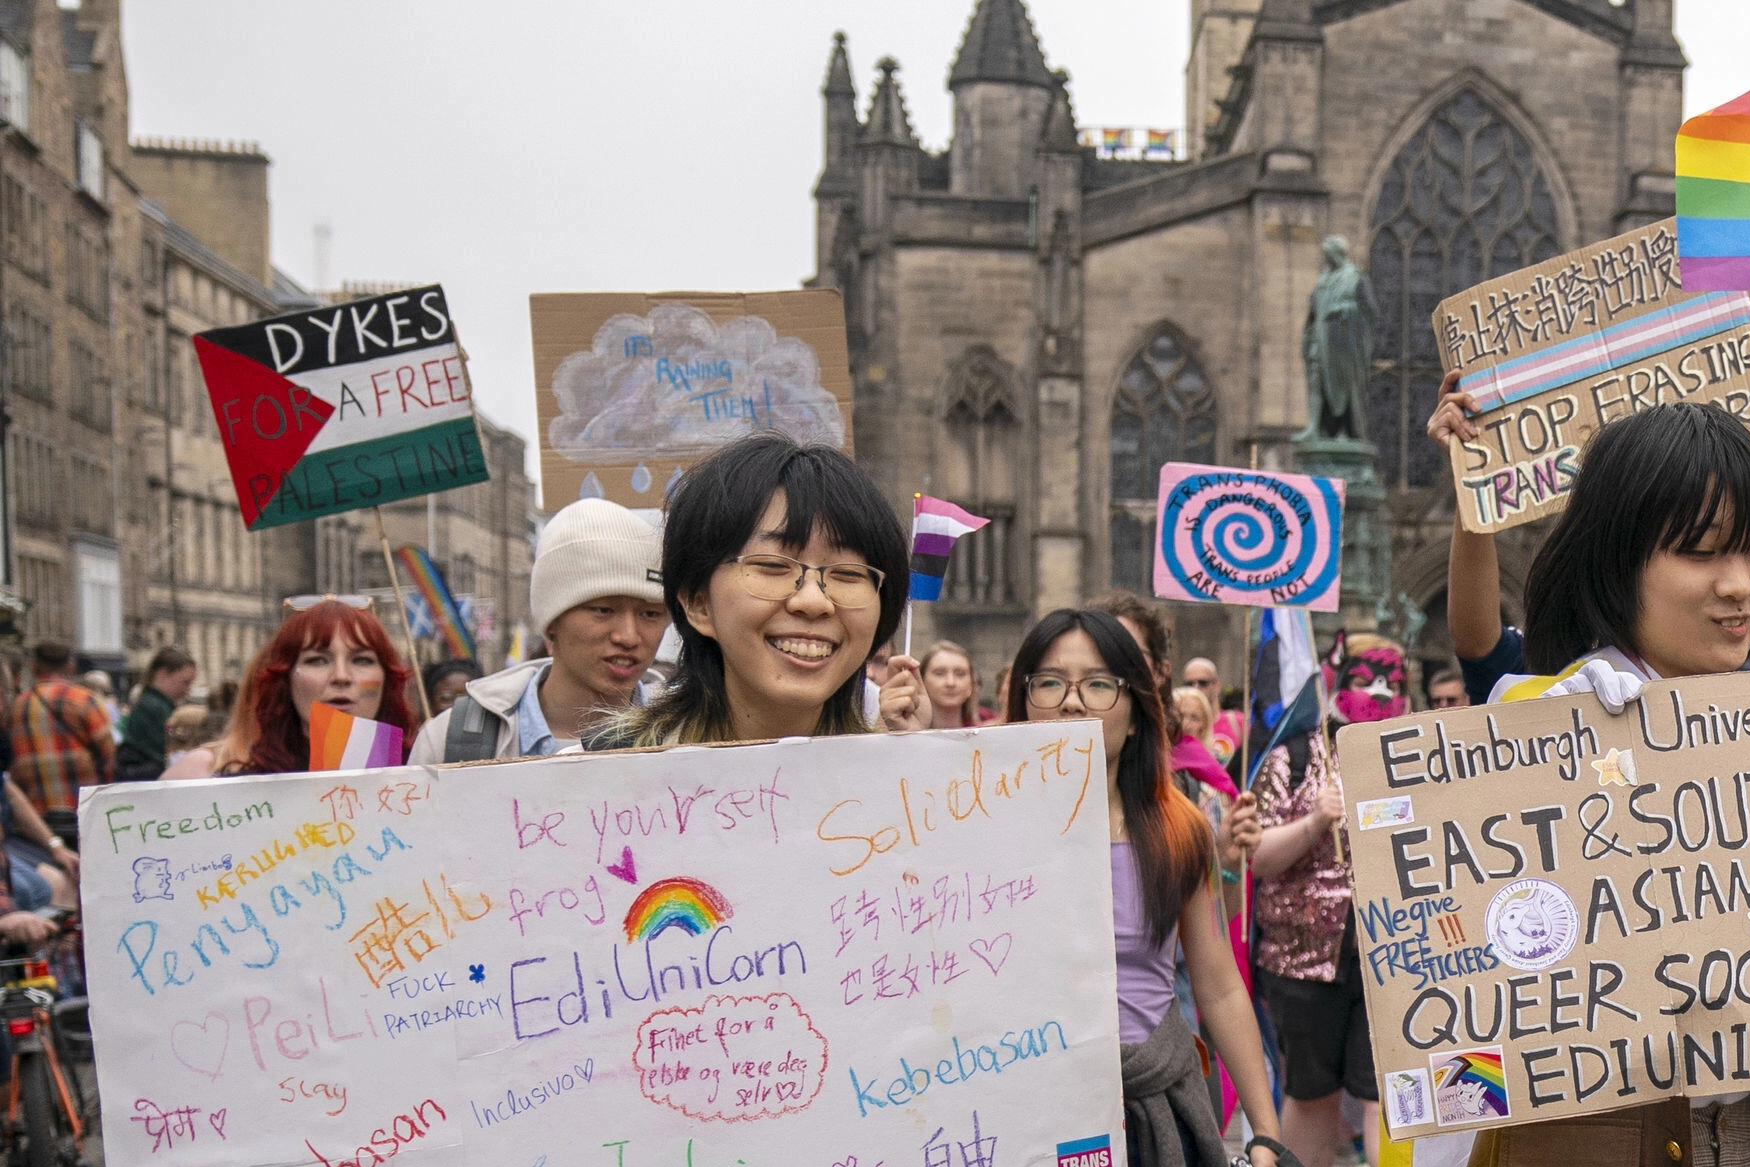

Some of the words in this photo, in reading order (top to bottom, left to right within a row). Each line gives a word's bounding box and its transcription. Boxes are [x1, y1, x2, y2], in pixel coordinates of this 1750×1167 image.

[265, 291, 448, 373] DYKES
[222, 386, 327, 447] FOR
[339, 381, 365, 421] A
[370, 356, 471, 418] FREE
[656, 358, 732, 391] RAINING
[1463, 394, 1578, 472] STOP
[250, 430, 486, 520] PALESTINE
[1463, 446, 1580, 524] TRANS
[1184, 515, 1202, 531] IS
[1205, 493, 1293, 541] DANGEROUS
[1186, 571, 1224, 599] ARE
[1270, 572, 1310, 603] NOT
[1201, 543, 1241, 583] TRANS
[1246, 559, 1296, 586] PEOPLE
[1380, 708, 1599, 788] Edinburgh
[105, 800, 274, 854] Freedom
[512, 798, 566, 850] be
[588, 767, 789, 864] yourself
[818, 738, 1094, 877] Solidarity
[1391, 803, 1567, 899] EAST
[1578, 790, 1631, 861] &
[349, 873, 492, 989] 酷儿
[508, 875, 606, 936] frog
[387, 970, 456, 1000] FUCK
[509, 924, 806, 1041] EdiUniCorn
[840, 951, 970, 1006] 也是女性
[1367, 936, 1432, 986] FREE
[1412, 943, 1501, 990] STICKERS
[384, 994, 503, 1040] PATRIARCHY
[1401, 958, 1641, 1050] QUEER
[715, 1017, 757, 1058] for
[470, 1073, 577, 1129] Inclusivo
[700, 1068, 721, 1103] og
[1442, 1112, 1466, 1124] MONTH
